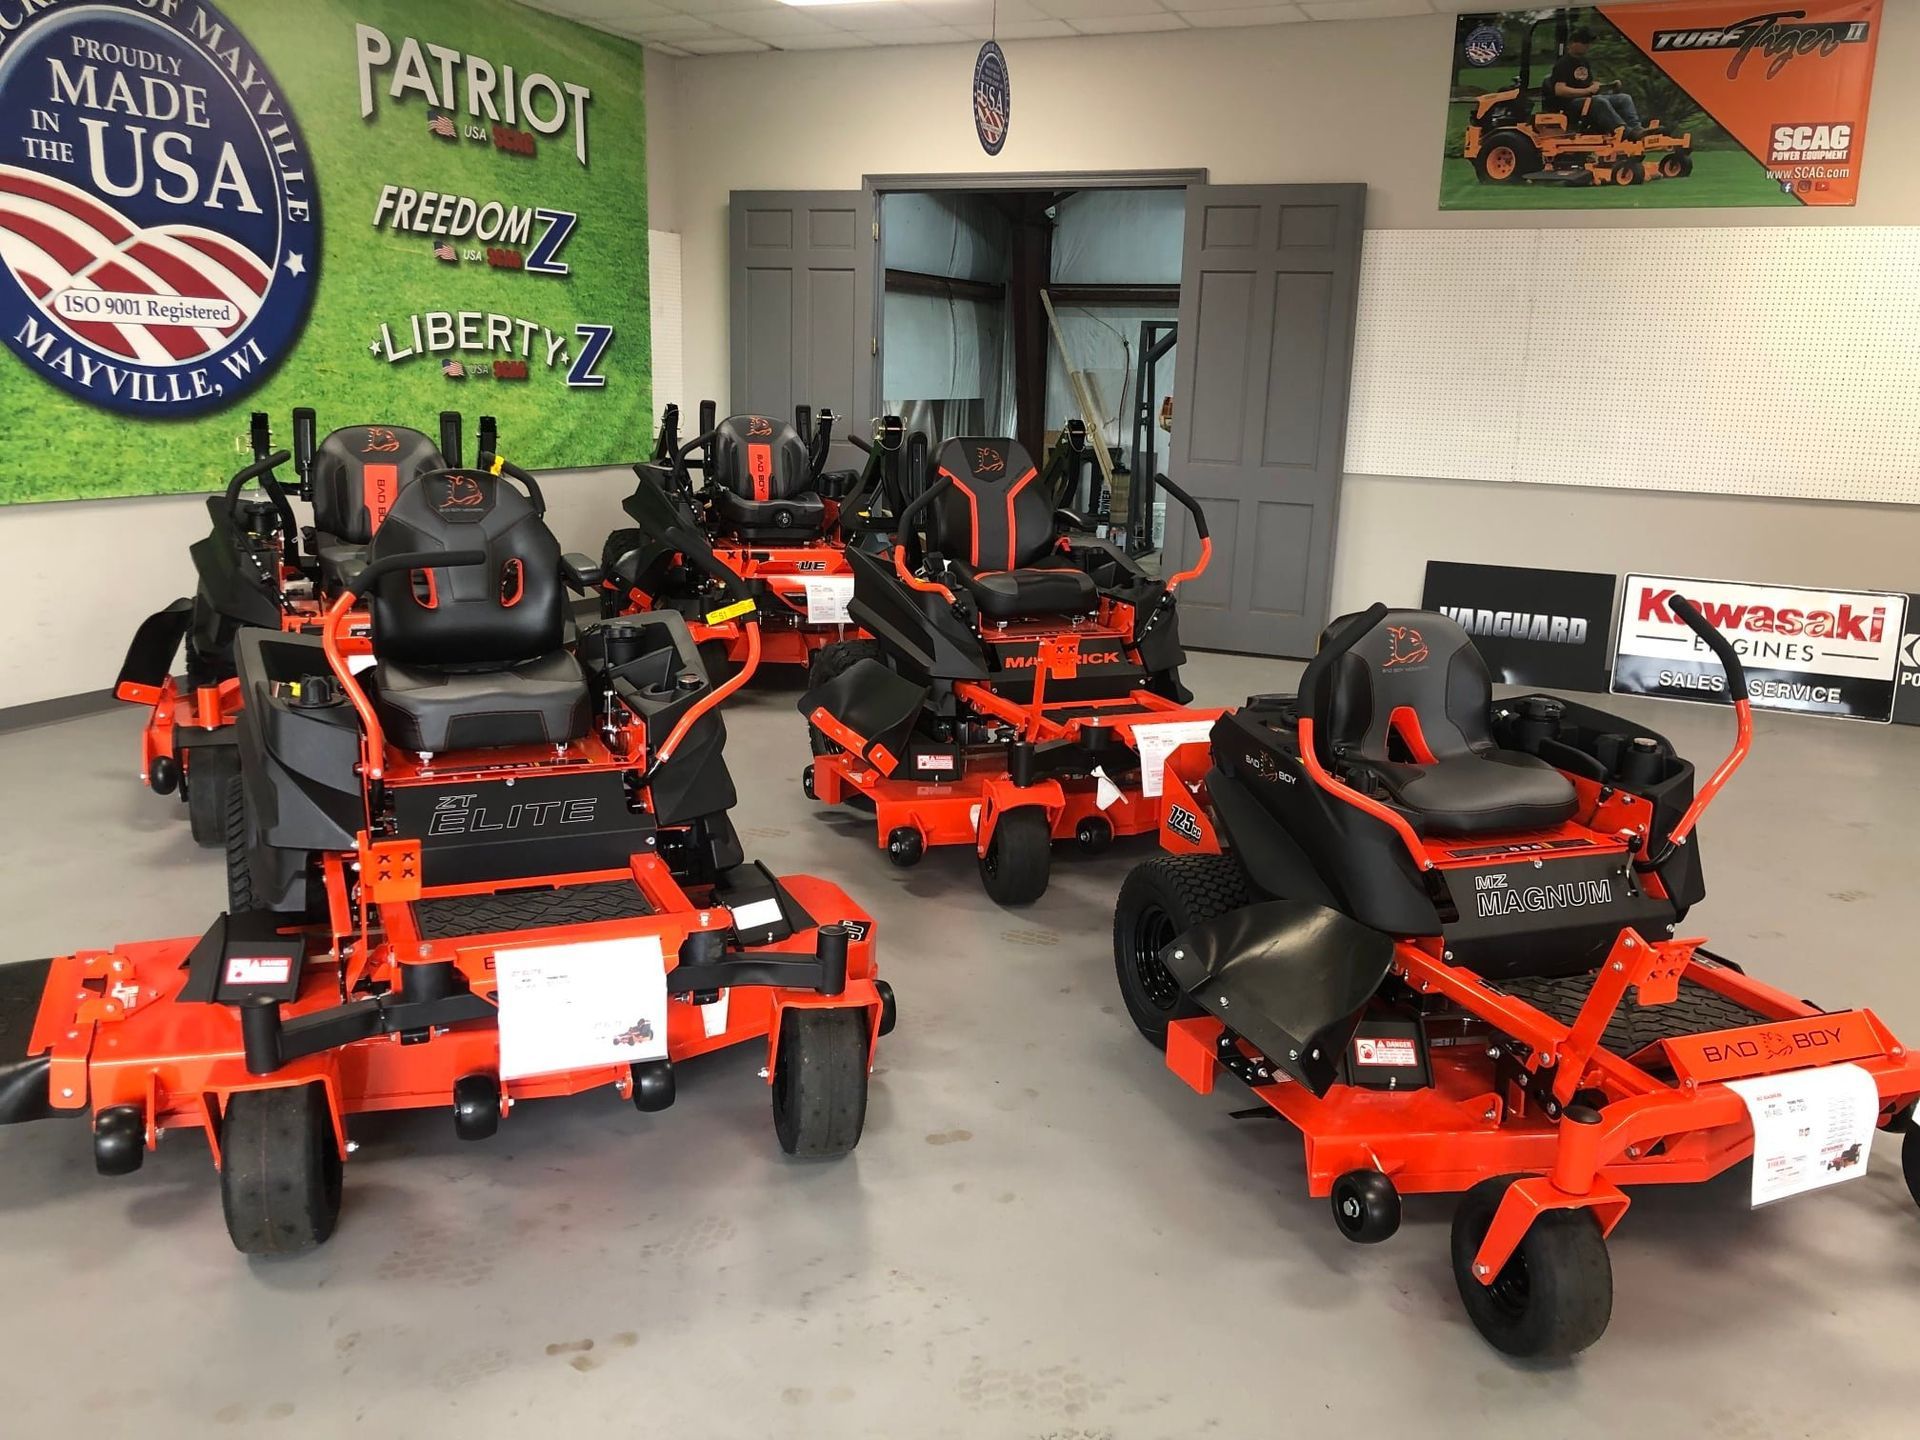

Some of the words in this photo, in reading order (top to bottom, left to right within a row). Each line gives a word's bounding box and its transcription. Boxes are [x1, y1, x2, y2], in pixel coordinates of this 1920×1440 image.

[72, 36, 181, 77] PROUDLY
[1655, 29, 1744, 49] TURF
[1725, 10, 1840, 80] Tiger
[46, 57, 211, 130] MADE
[355, 22, 591, 165] PATRIOT
[31, 109, 61, 133] IN
[188, 6, 311, 223] MAYVILLE
[464, 124, 487, 141] USA
[1773, 125, 1850, 151] SCAG
[22, 136, 75, 163] THE
[1771, 151, 1801, 161] POWER
[1801, 150, 1848, 161] EQUIPMENT
[79, 117, 263, 215] USA
[1766, 166, 1850, 180] www.SCAG.com
[463, 248, 482, 261] USA
[64, 295, 100, 314] ISO
[105, 297, 142, 316] 9001
[147, 300, 231, 323] Registered
[379, 311, 567, 367] LIBERTY
[13, 315, 224, 403] MAYVILLE,
[220, 337, 268, 382] WI
[377, 479, 386, 504] BAD
[1694, 635, 1815, 662] EGINES
[1659, 671, 1723, 692] SALES
[1749, 680, 1842, 704] SERVICE
[1245, 754, 1260, 769] BAD
[1278, 770, 1297, 785] BOY
[428, 798, 597, 836] ELITE
[435, 793, 478, 810] ZT
[1474, 873, 1508, 891] MZ
[1476, 878, 1612, 918] MAGNUM
[1702, 1040, 1758, 1063] BAD
[1792, 1027, 1841, 1049] BOY
